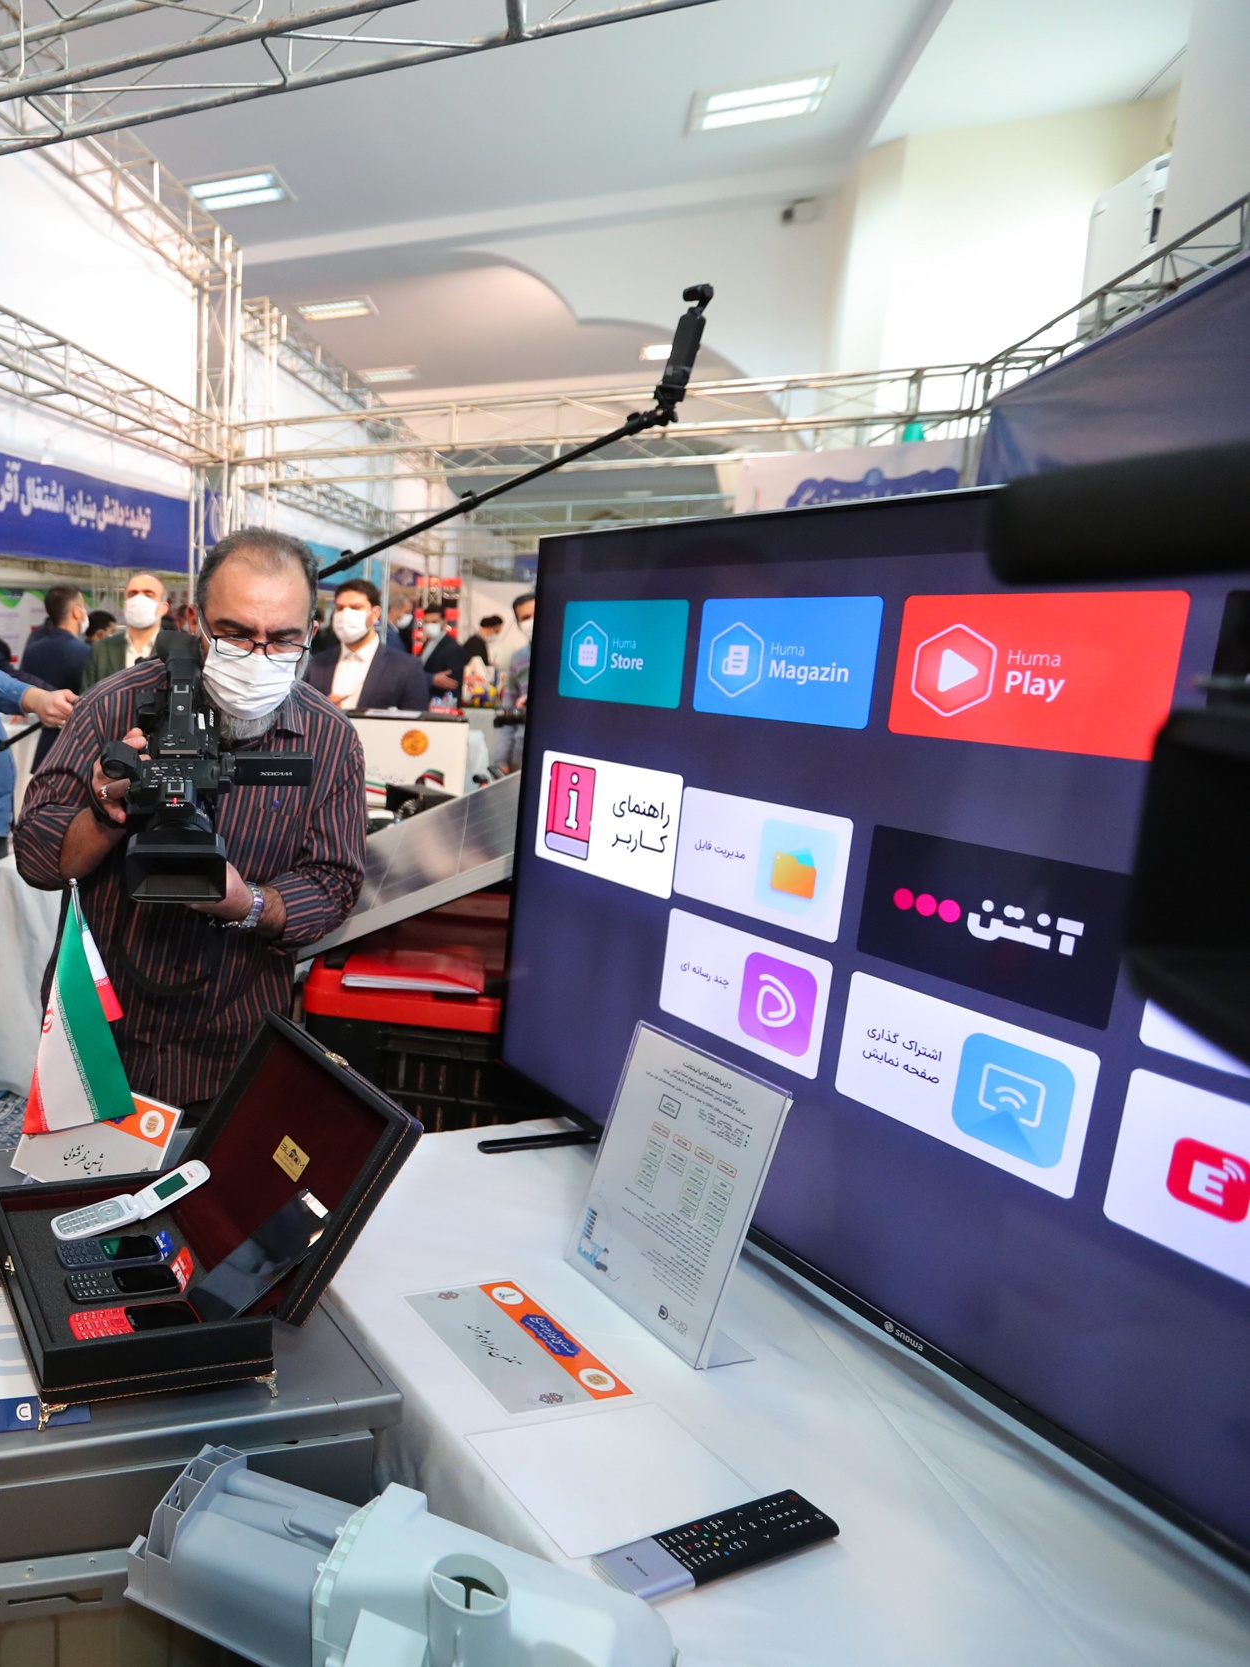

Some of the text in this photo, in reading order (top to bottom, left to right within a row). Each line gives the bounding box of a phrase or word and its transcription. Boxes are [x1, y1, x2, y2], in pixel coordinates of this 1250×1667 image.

[20, 475, 65, 517] اشتغال
[612, 637, 637, 649] Huma
[770, 642, 805, 657] Huma
[610, 652, 644, 671] Store
[1007, 648, 1061, 668] Huma
[768, 659, 849, 685] Magazin
[1004, 672, 1065, 703] Play
[612, 795, 670, 828] راهنمای
[611, 830, 668, 853] کاربر
[694, 839, 746, 860] مدیریت فایل
[967, 899, 1084, 956] آنتن
[680, 961, 729, 989] چند رسانه ای
[867, 1028, 942, 1062] اشتراک گذاری
[862, 1048, 939, 1084] صفحه نمایش
